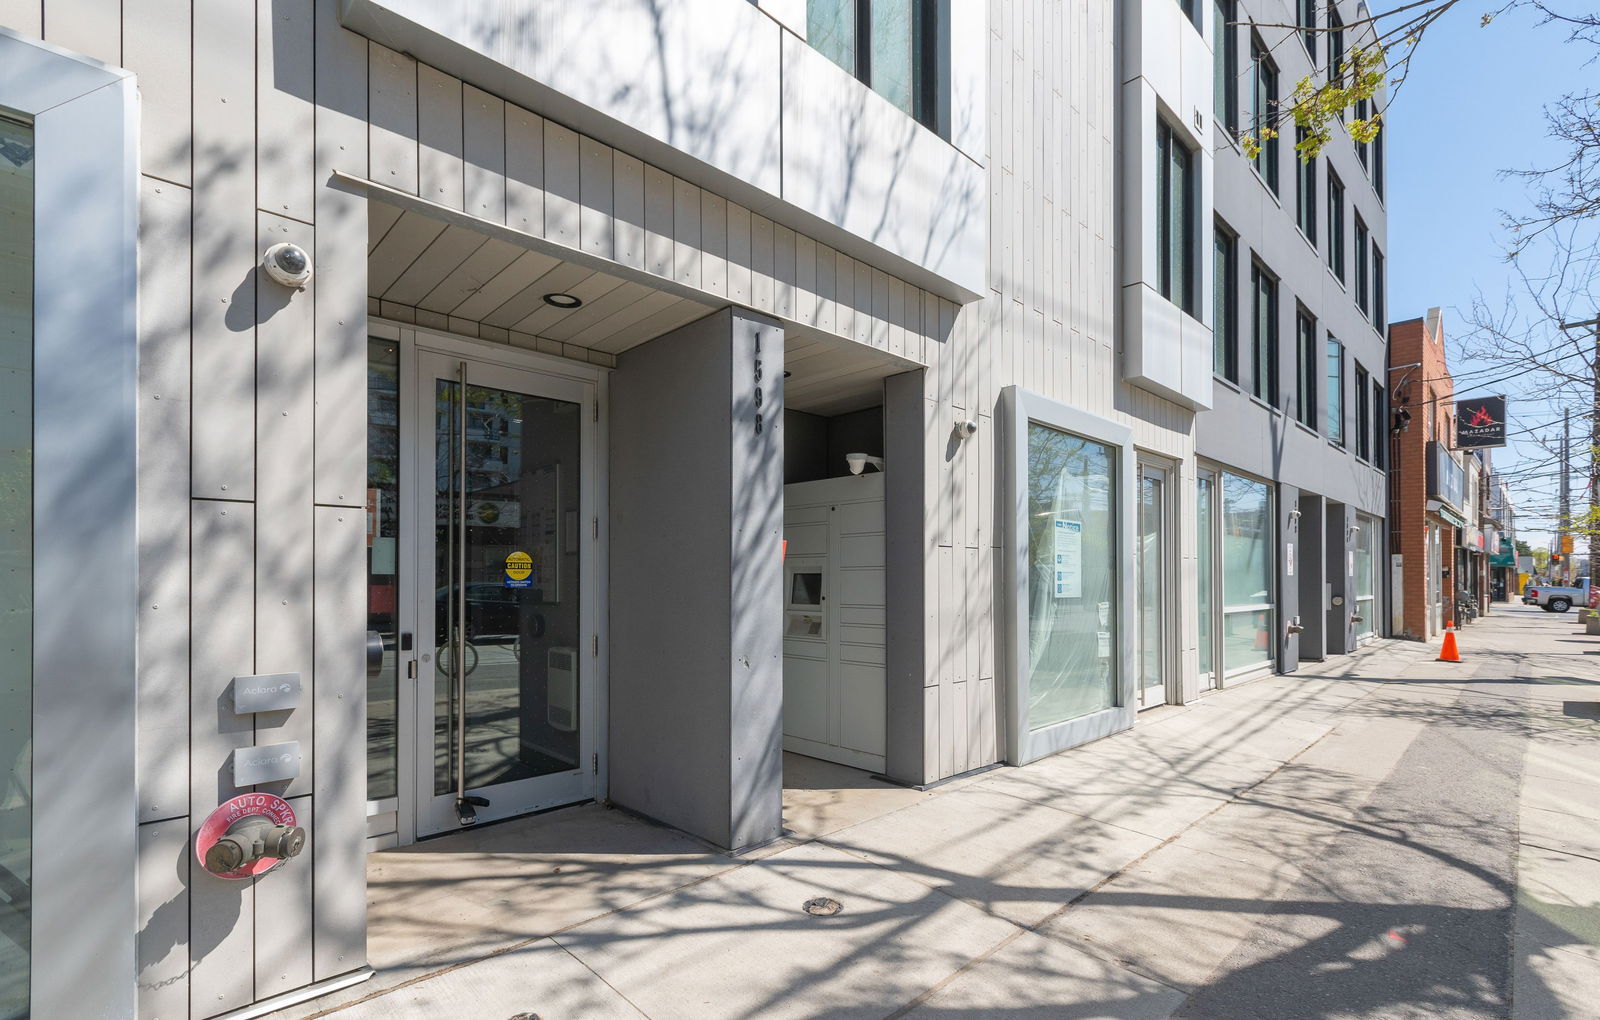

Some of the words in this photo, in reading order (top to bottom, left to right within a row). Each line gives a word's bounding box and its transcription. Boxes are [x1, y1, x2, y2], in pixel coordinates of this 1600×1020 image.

[754, 331, 763, 435] 1598
[229, 796, 267, 813] AUTO.
[226, 811, 242, 823] FIRE
[262, 808, 281, 826] CONNEC
